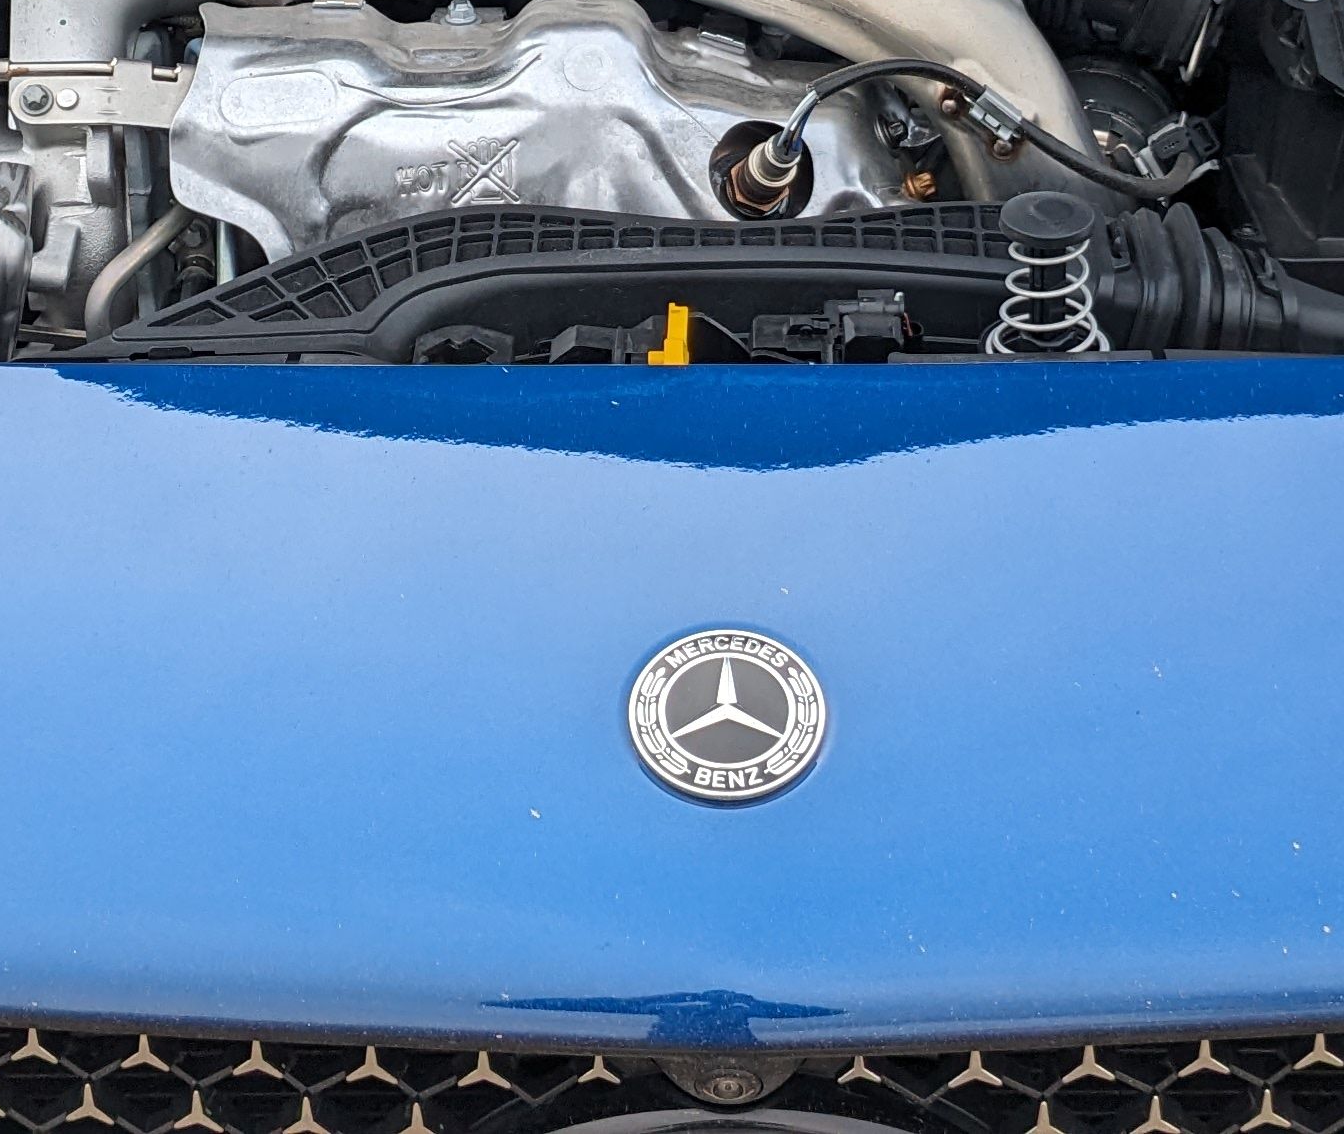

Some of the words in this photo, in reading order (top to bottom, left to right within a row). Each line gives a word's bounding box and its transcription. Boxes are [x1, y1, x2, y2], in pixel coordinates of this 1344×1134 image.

[396, 161, 448, 197] HOT
[664, 635, 789, 669] MERCEDES
[693, 767, 763, 789] BENZ
